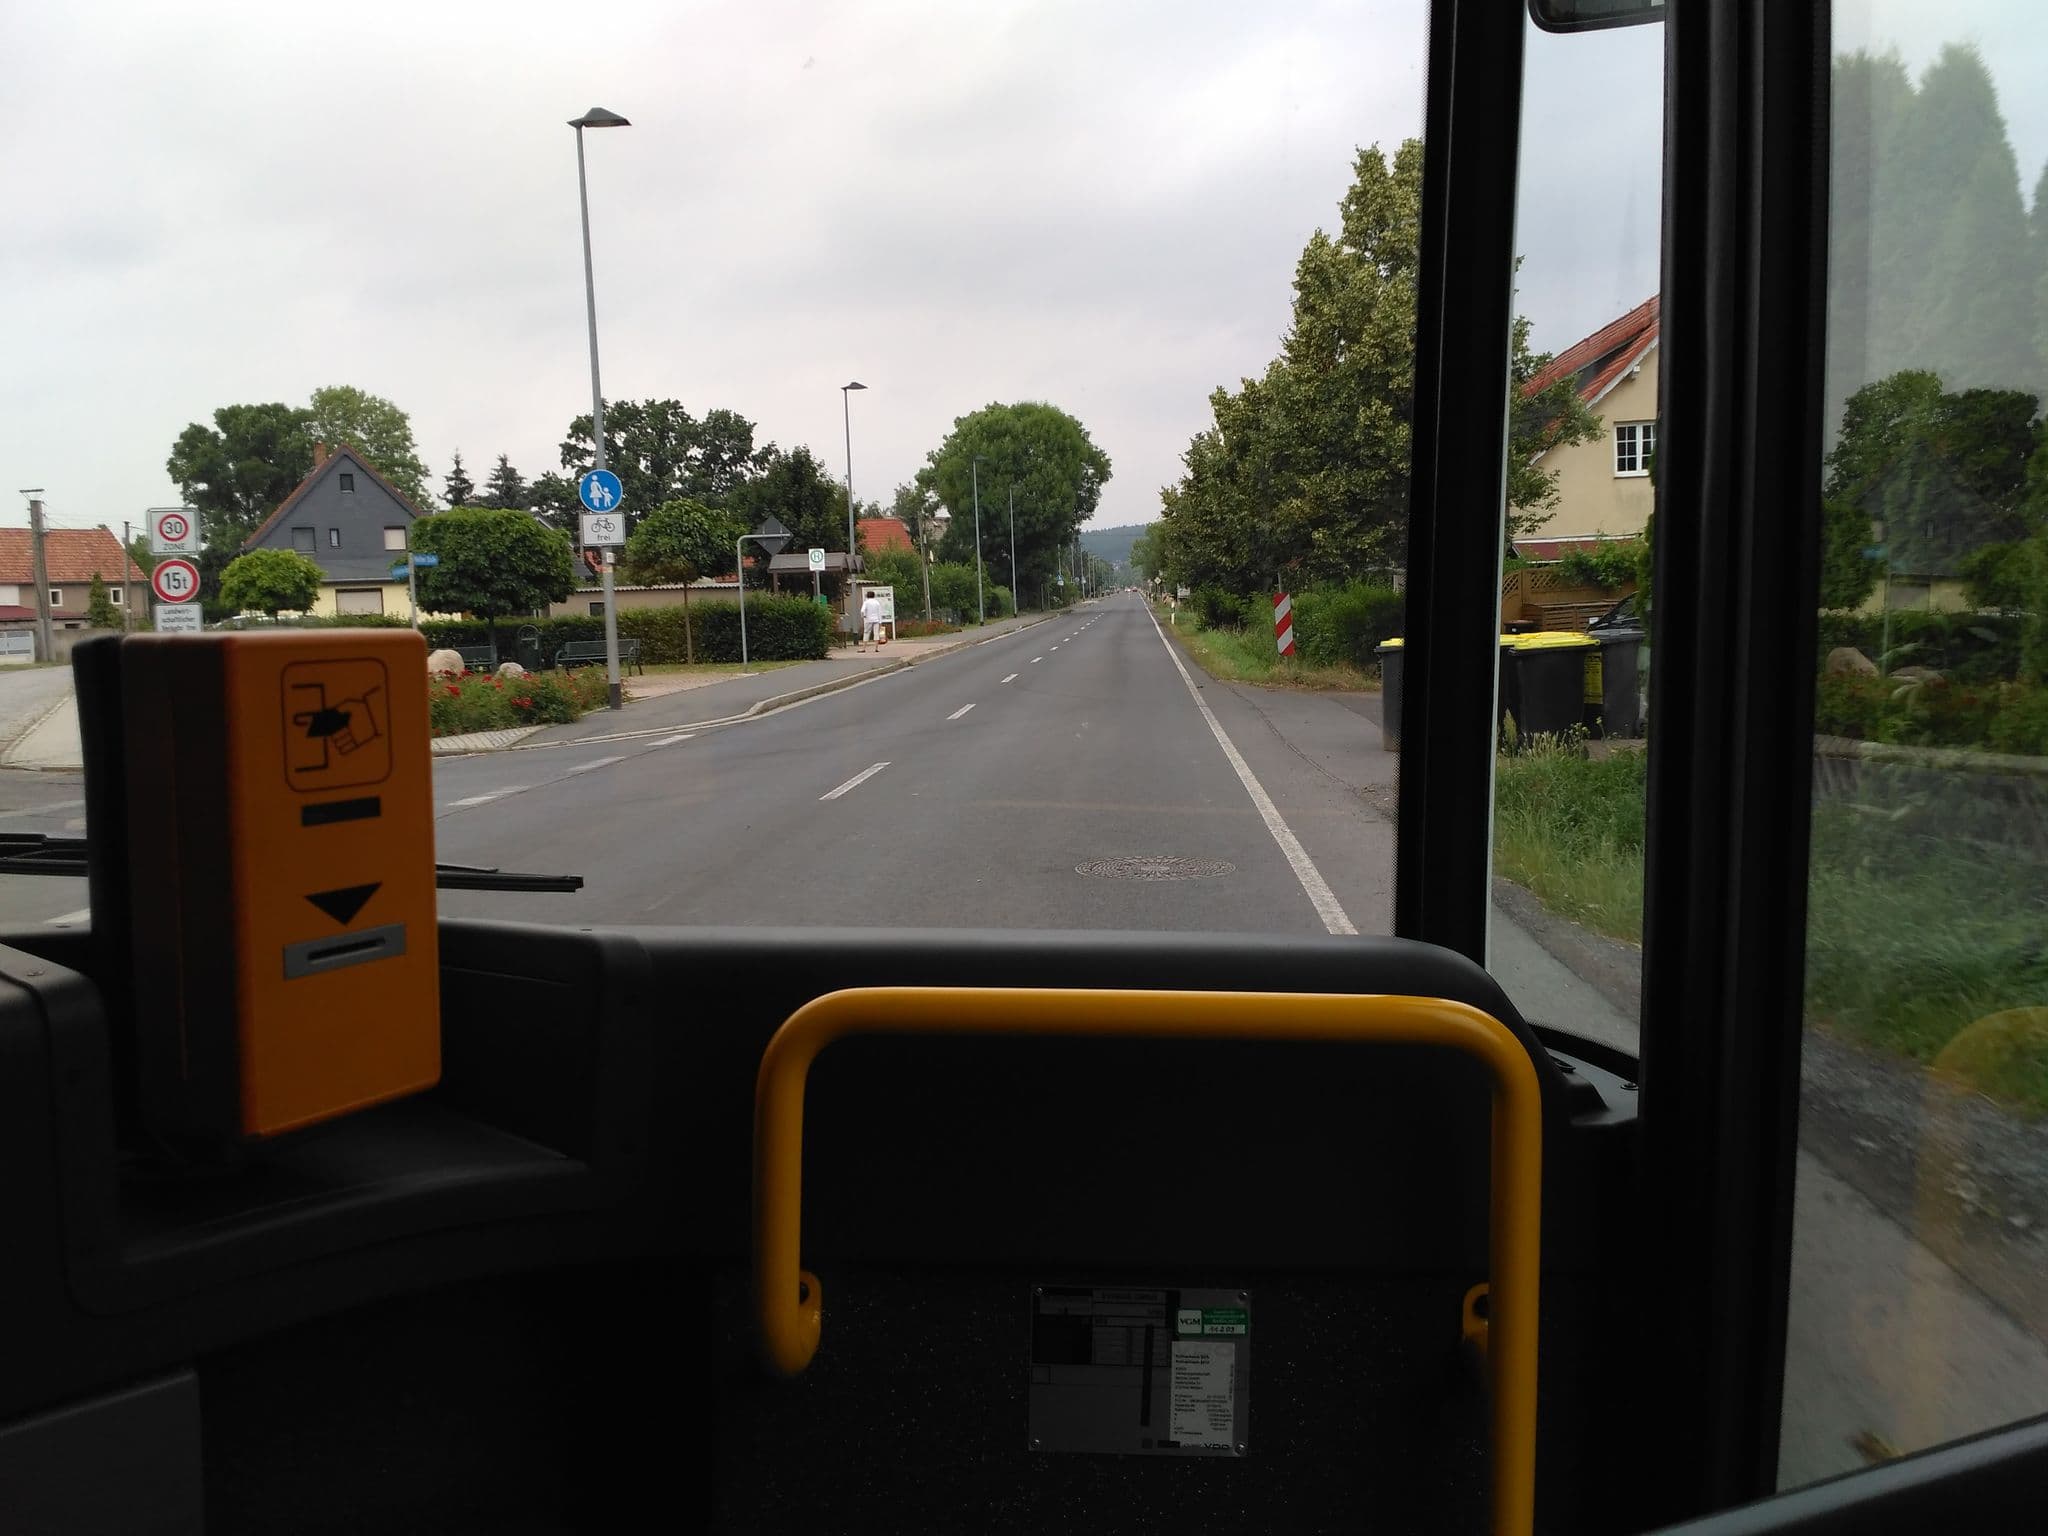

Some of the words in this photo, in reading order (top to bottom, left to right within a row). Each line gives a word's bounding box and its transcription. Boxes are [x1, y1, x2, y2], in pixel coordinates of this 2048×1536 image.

[164, 521, 183, 534] 30
[597, 533, 610, 542] frei
[163, 543, 185, 551] ZONE
[1179, 1318, 1201, 1326] VGM
